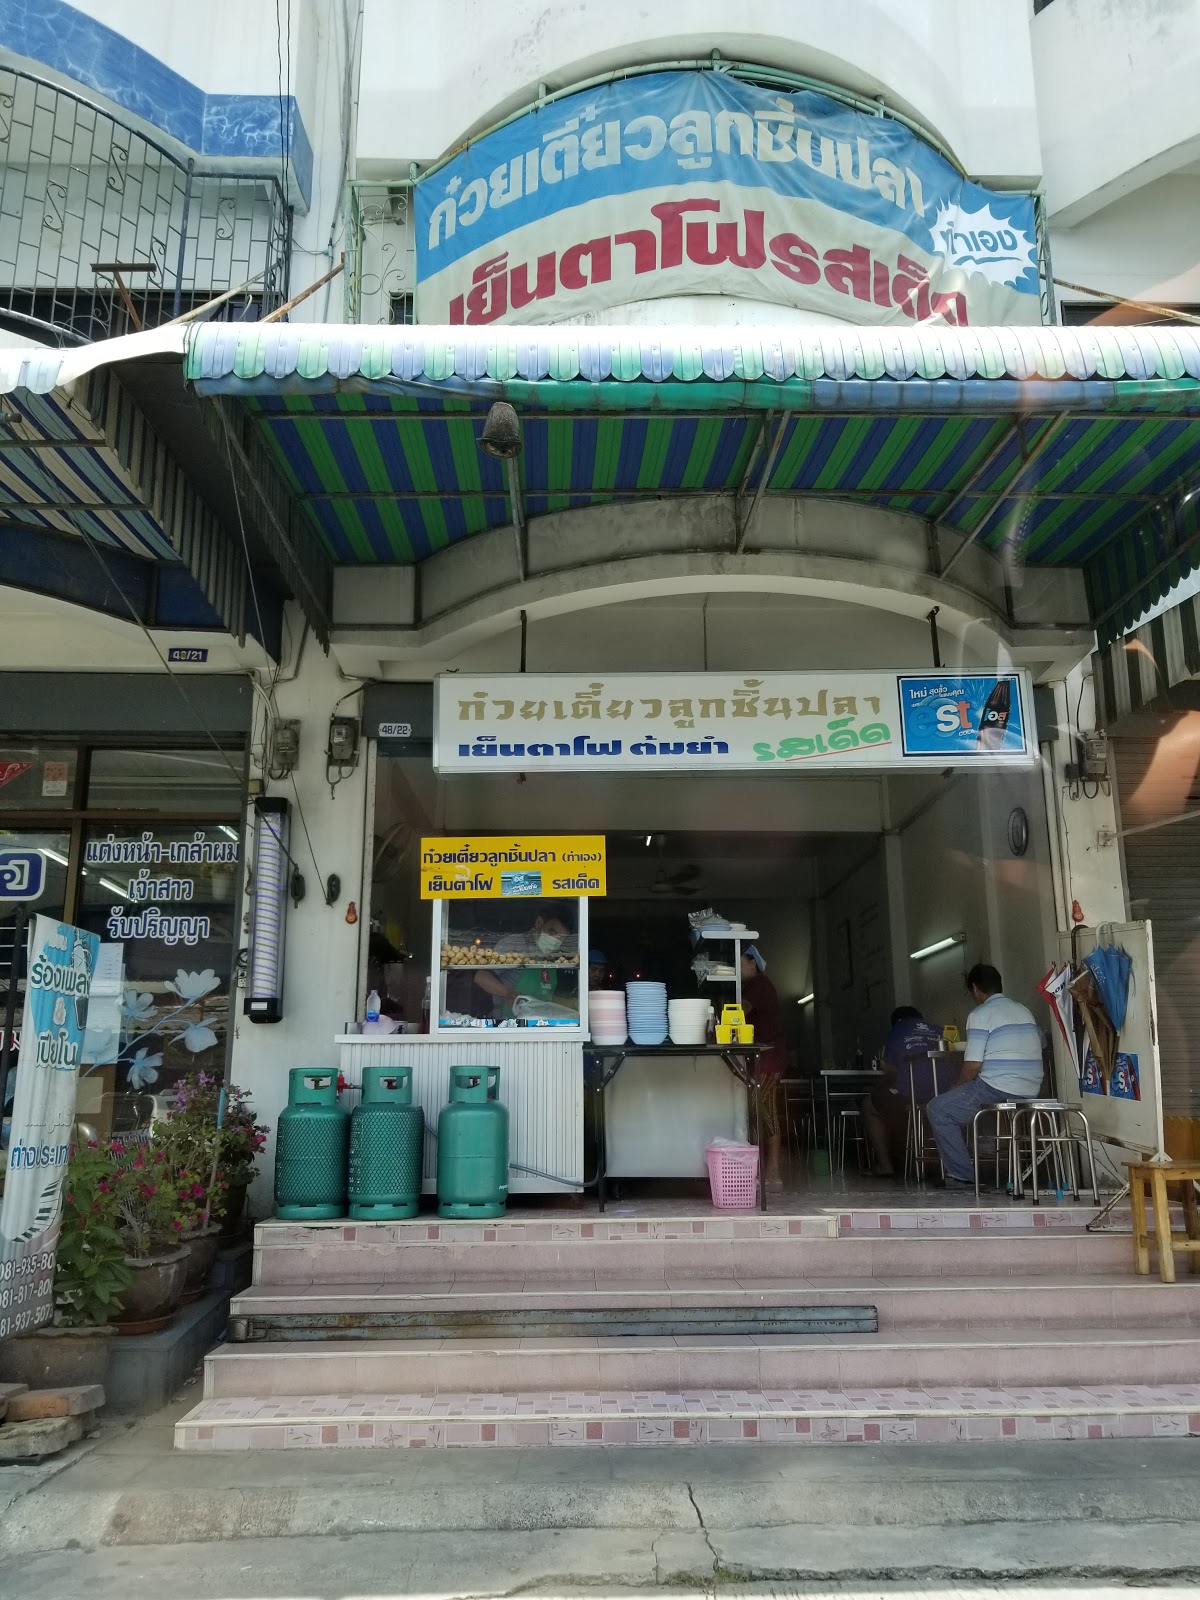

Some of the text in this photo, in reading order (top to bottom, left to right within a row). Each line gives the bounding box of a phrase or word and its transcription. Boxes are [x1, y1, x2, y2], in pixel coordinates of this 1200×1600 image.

[429, 97, 924, 250] ก๋วยเตี๋ยวลูกชิ้นปลา
[940, 221, 1018, 255] ทำเอง
[458, 678, 880, 729] ก๋วยเตี๋ยวลูกชิ้นปลา
[382, 725, 408, 735] 48/22
[458, 735, 729, 757] เย็นตาโฟ ต้มยำ
[86, 833, 239, 863] แต่งหน้า-เกล้าผม
[423, 843, 556, 867] ก๋วยเตี๋ยวลูกชิ้นปลา
[129, 869, 193, 900] เจ้าสาว
[428, 874, 494, 892] เย็นตาโฟ
[552, 872, 600, 890] รสเด็ด
[107, 906, 209, 945] รับปริญญา
[37, 1030, 76, 1066] เปียโน
[11, 1138, 69, 1169] ต่างประเท
[0, 1251, 56, 1280] 081-935-80
[0, 1278, 53, 1308] 81-817-80
